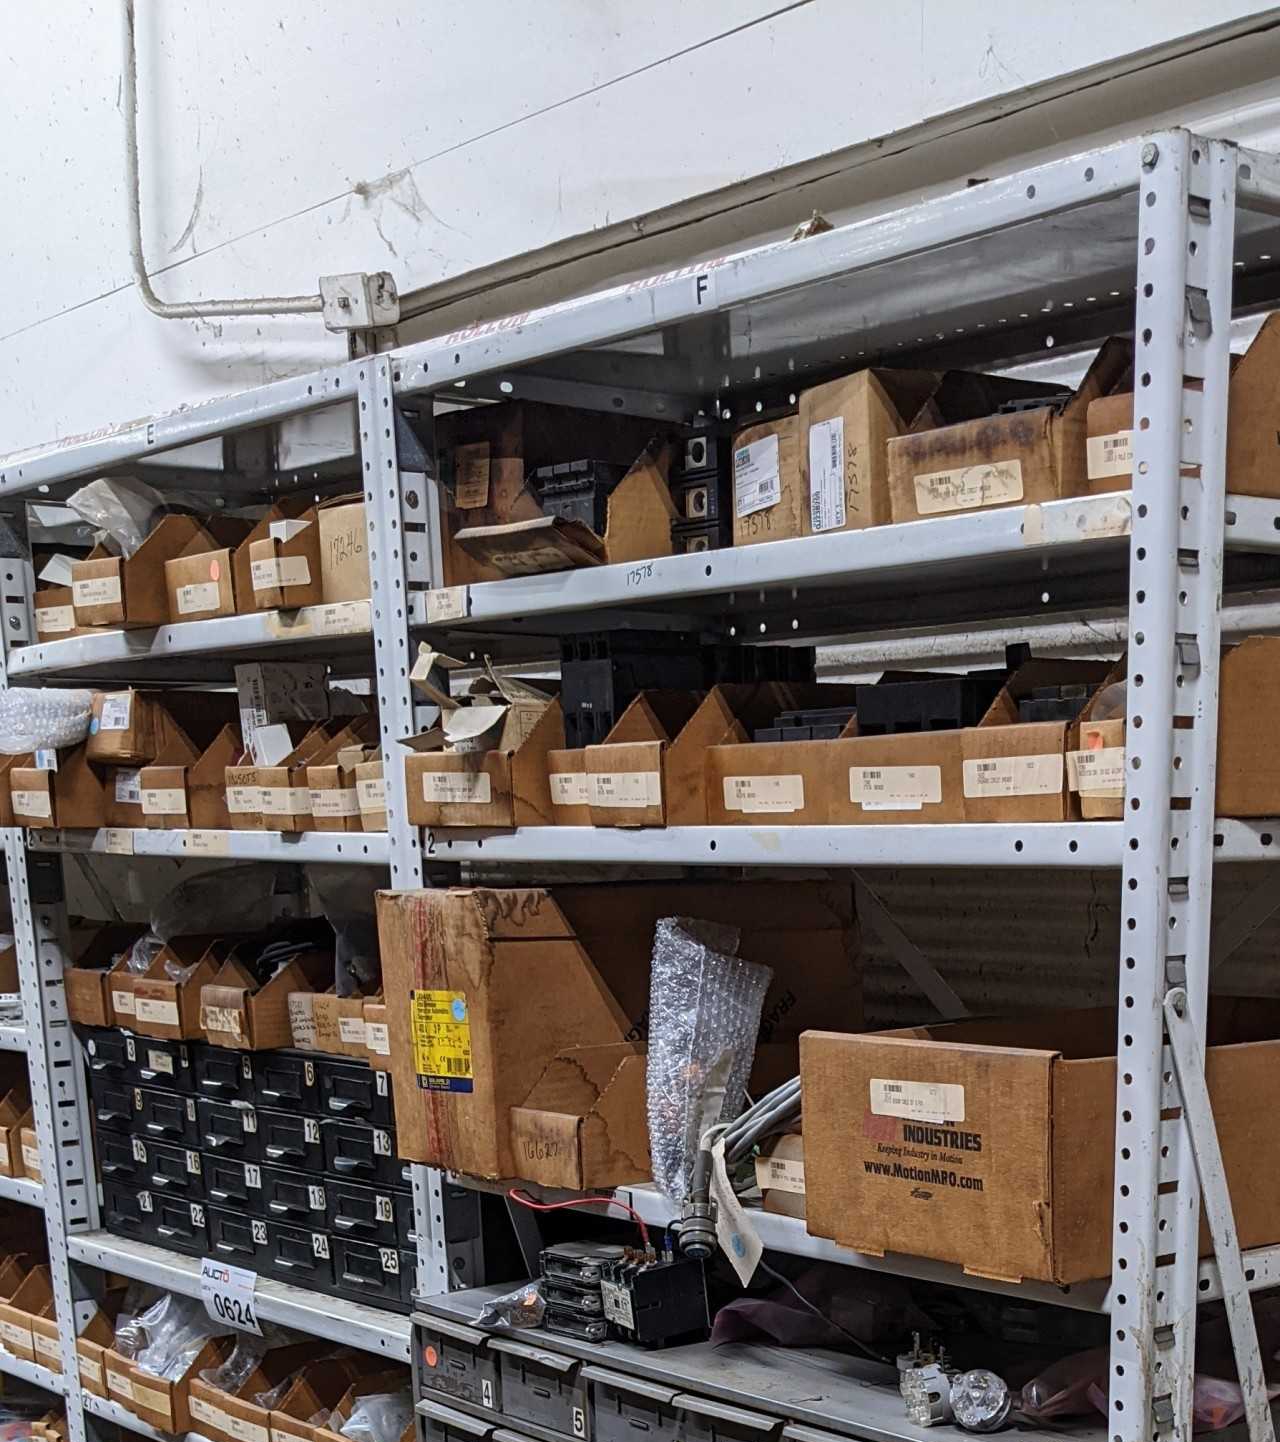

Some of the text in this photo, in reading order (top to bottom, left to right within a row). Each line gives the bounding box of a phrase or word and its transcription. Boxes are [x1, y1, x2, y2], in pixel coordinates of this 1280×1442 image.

[696, 275, 708, 305] F
[147, 424, 155, 445] E
[626, 561, 655, 587] 17578
[428, 832, 436, 855] 2
[306, 1063, 315, 1082] 6
[377, 1074, 386, 1093] 7
[306, 1121, 318, 1141] 12
[902, 1123, 982, 1153] INDUSTRIES
[188, 1151, 201, 1172] 16
[876, 1142, 902, 1159] Keeping
[903, 1145, 930, 1162] Industry
[938, 1151, 963, 1165] Motion
[247, 1165, 260, 1186] 17
[863, 1160, 985, 1192] www.MotionMRO.com
[139, 1191, 152, 1212] 21
[311, 1186, 325, 1207] 18
[191, 1204, 205, 1226] 22
[378, 1197, 393, 1219] 19
[252, 1221, 267, 1243] 23
[314, 1236, 328, 1257] 24
[383, 1250, 398, 1271] 25
[213, 1292, 257, 1328] 0624
[484, 1385, 492, 1406] 4
[574, 1412, 584, 1433] 5
